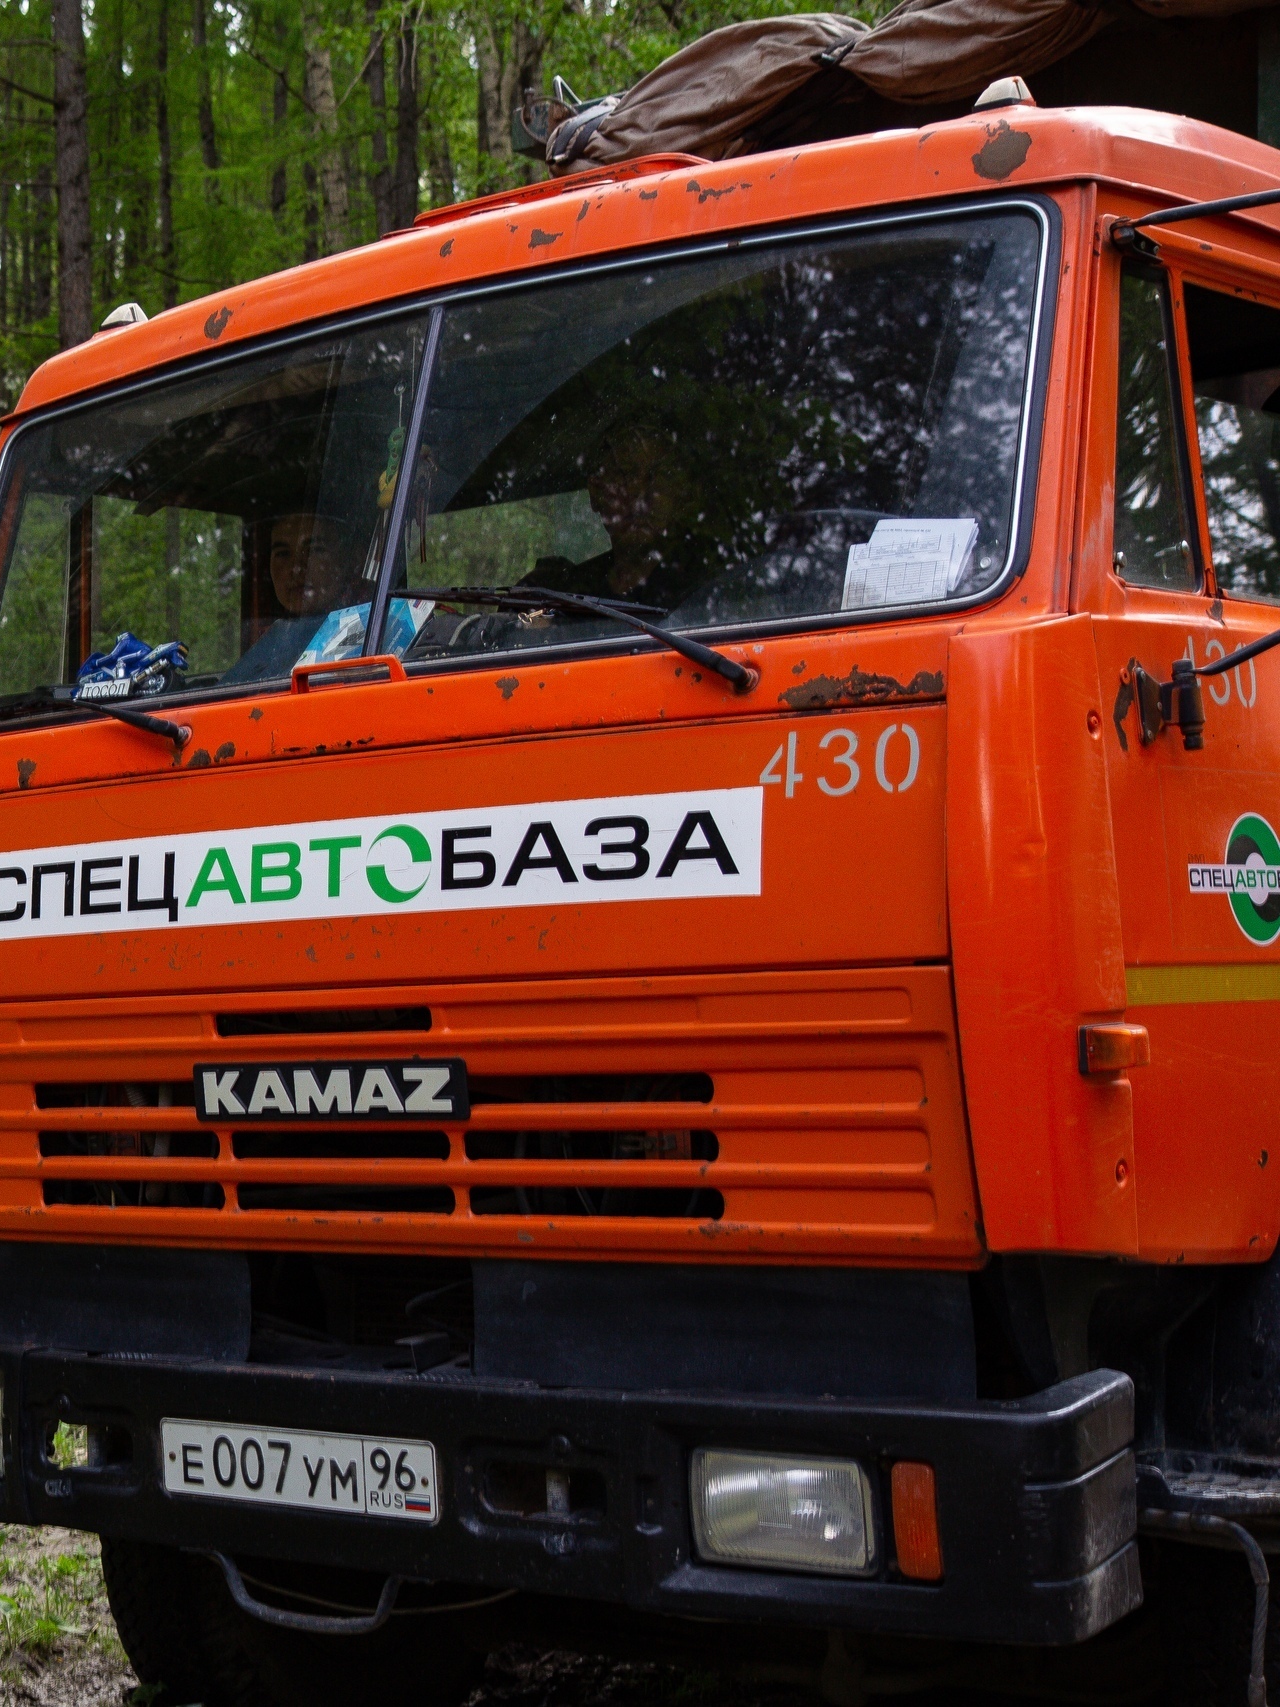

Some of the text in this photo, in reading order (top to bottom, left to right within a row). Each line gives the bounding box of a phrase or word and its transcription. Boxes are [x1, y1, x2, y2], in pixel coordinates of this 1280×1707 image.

[759, 724, 921, 799] 430
[1189, 868, 1280, 892] СПЕЦАВТО
[202, 1067, 454, 1115] KAMAZ
[369, 1446, 417, 1492] 96
[369, 1490, 404, 1509] RUS
